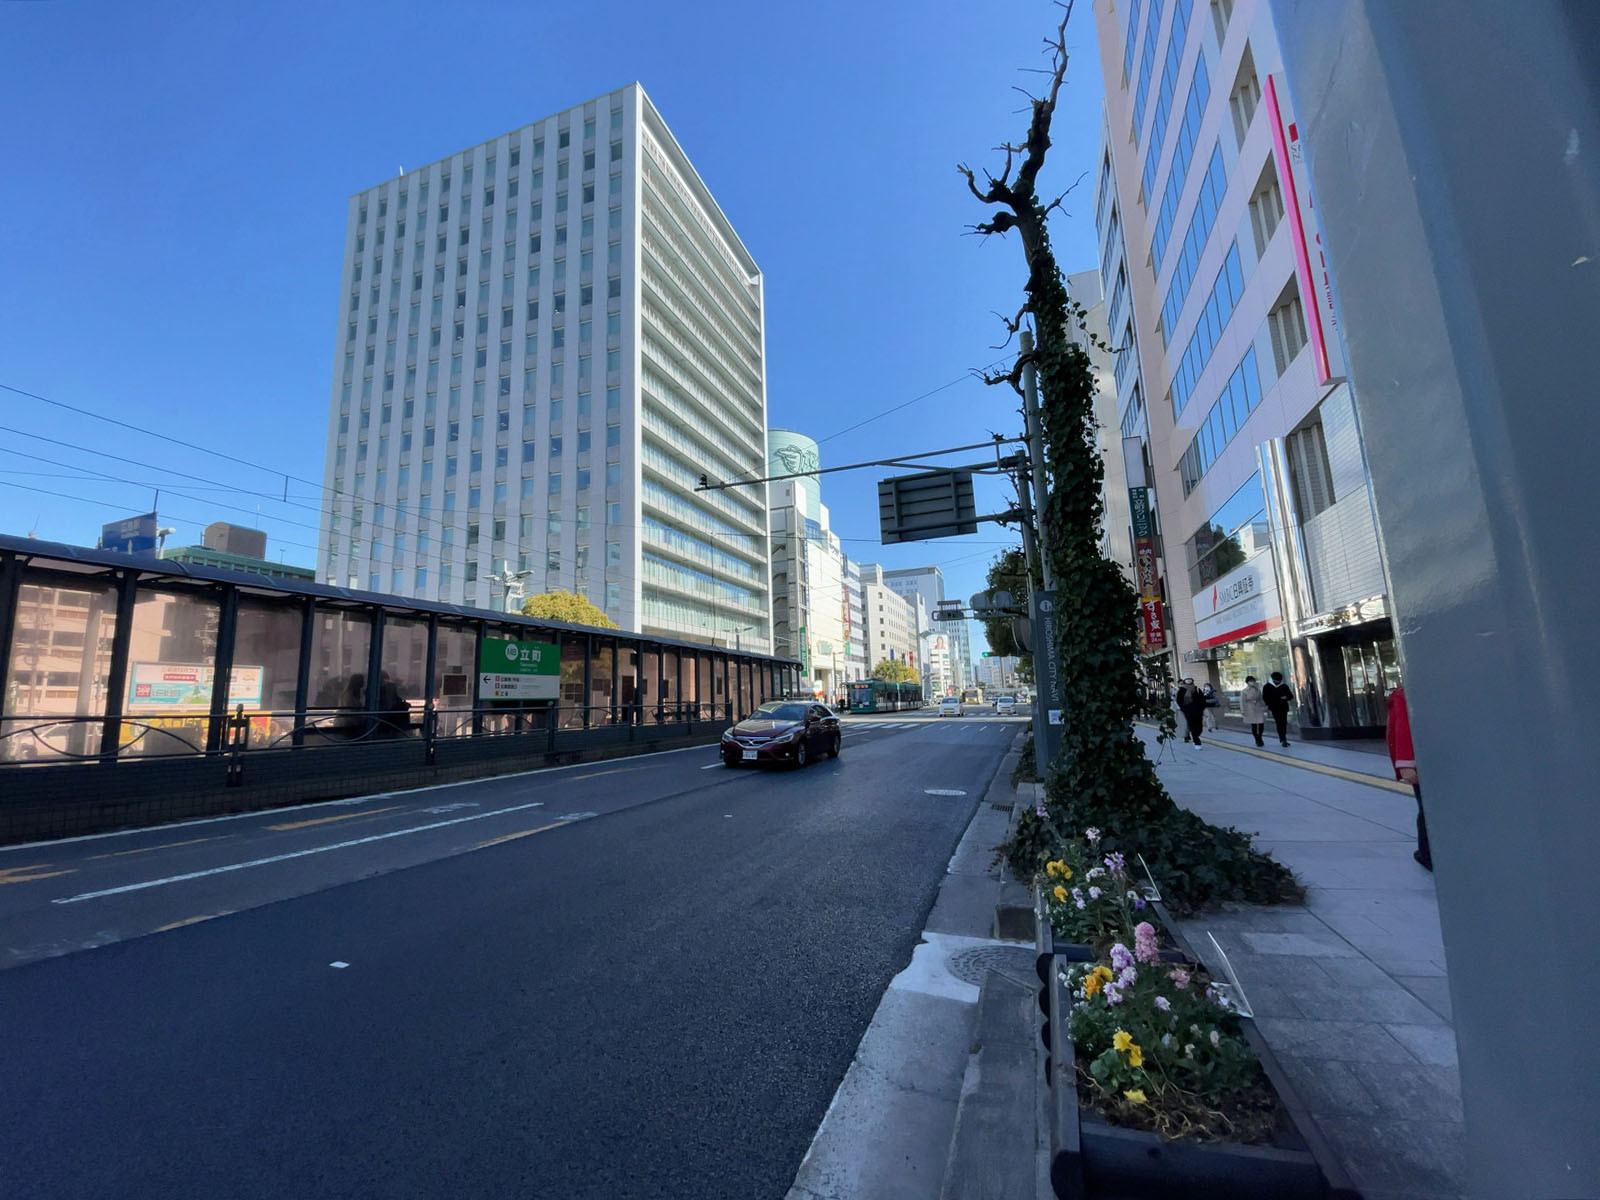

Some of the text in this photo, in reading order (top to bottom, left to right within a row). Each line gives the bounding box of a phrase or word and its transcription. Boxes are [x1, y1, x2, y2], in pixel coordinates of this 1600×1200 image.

[1044, 617, 1059, 701] HIROSHIMA CITY NAVI
